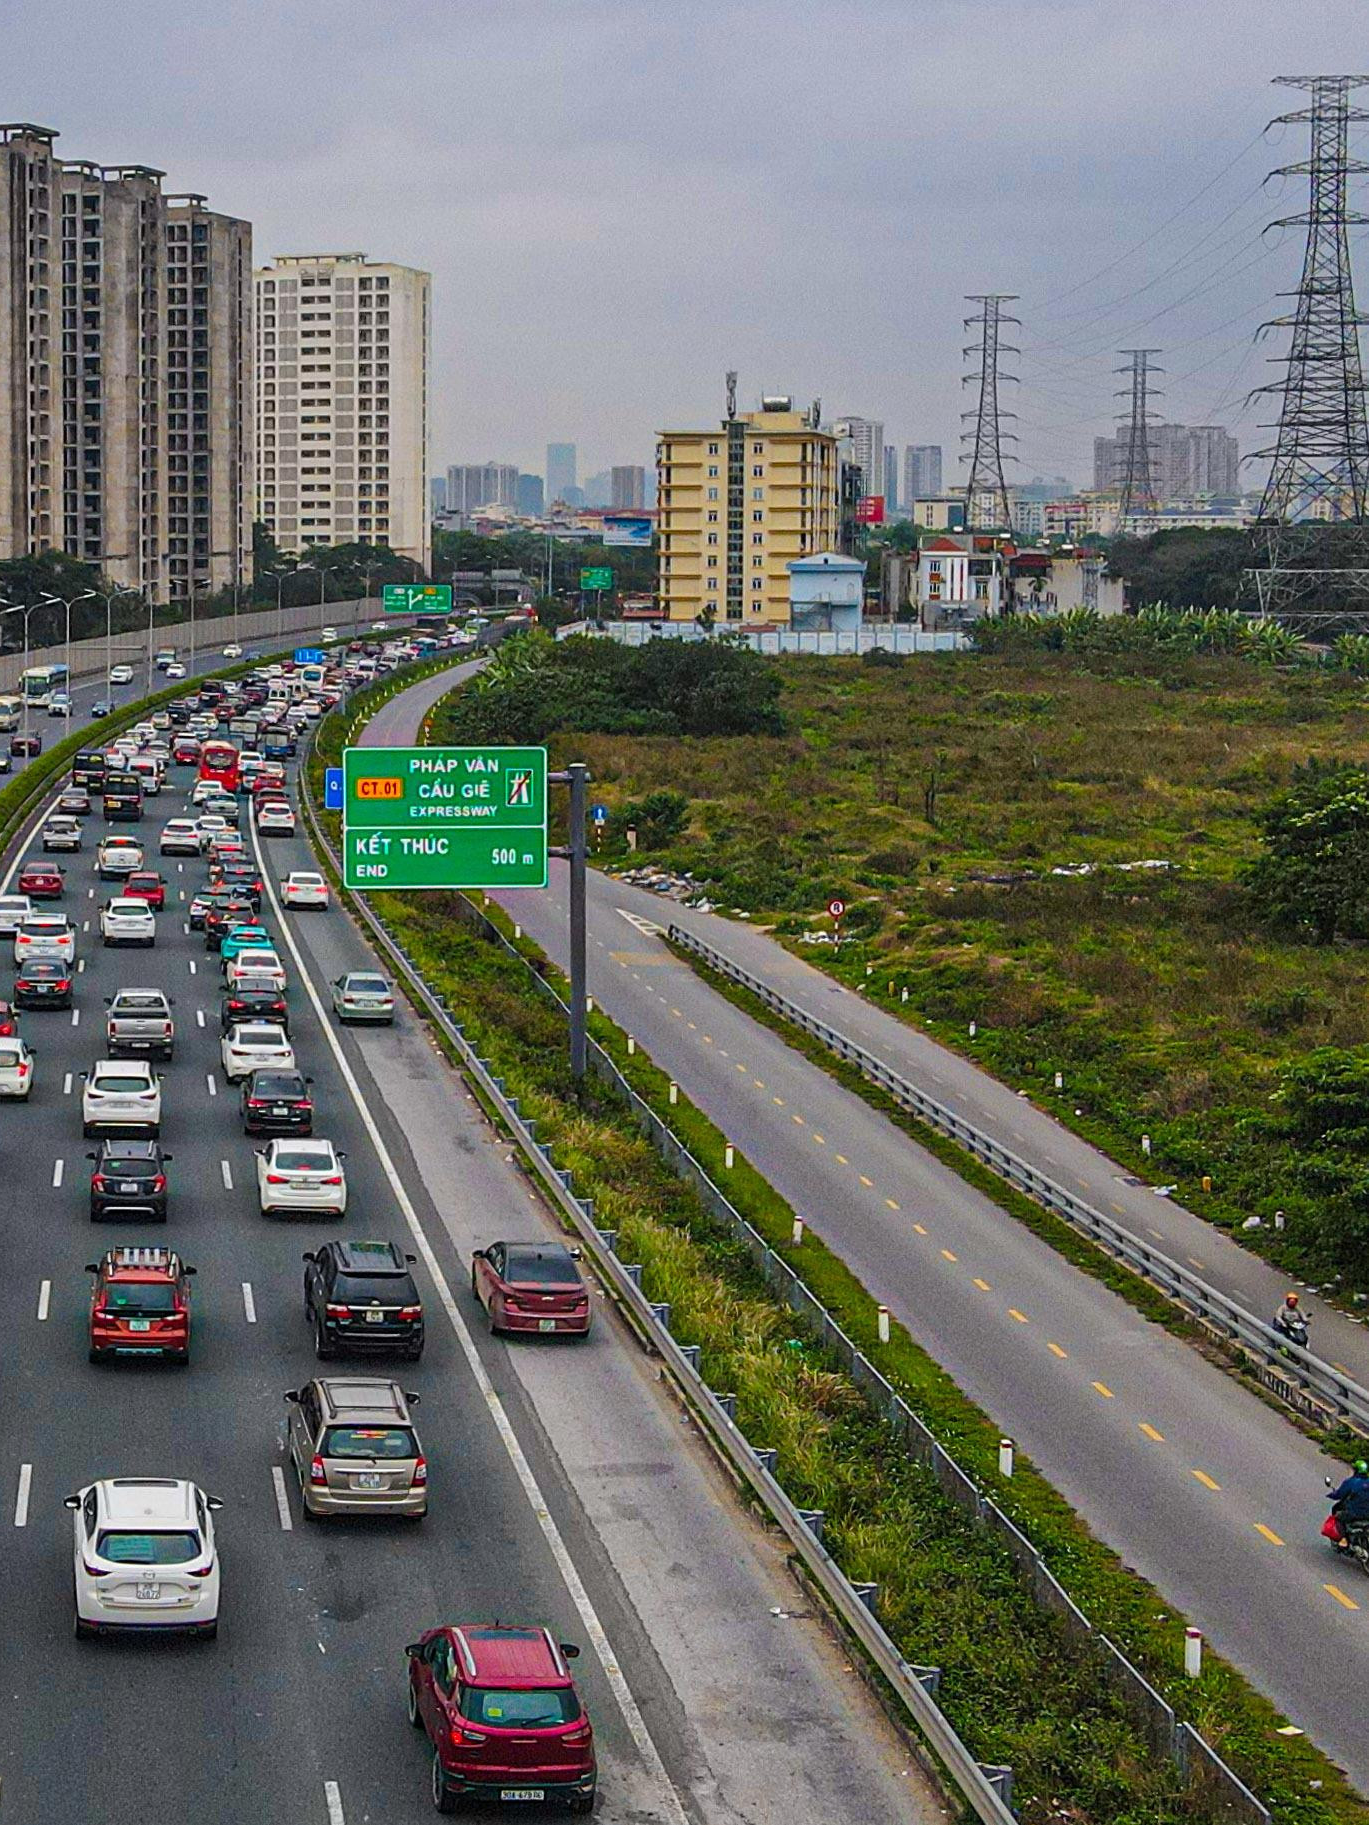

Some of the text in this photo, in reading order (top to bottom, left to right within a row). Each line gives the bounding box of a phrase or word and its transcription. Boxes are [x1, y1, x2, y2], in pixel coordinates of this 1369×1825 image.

[409, 753, 499, 773] PHÁP VÂN
[361, 781, 397, 796] CT.01
[409, 805, 498, 817] EXPRESSWAY
[356, 831, 449, 855] KẾT THÚC
[492, 848, 534, 865] 500 m
[356, 864, 388, 877] END
